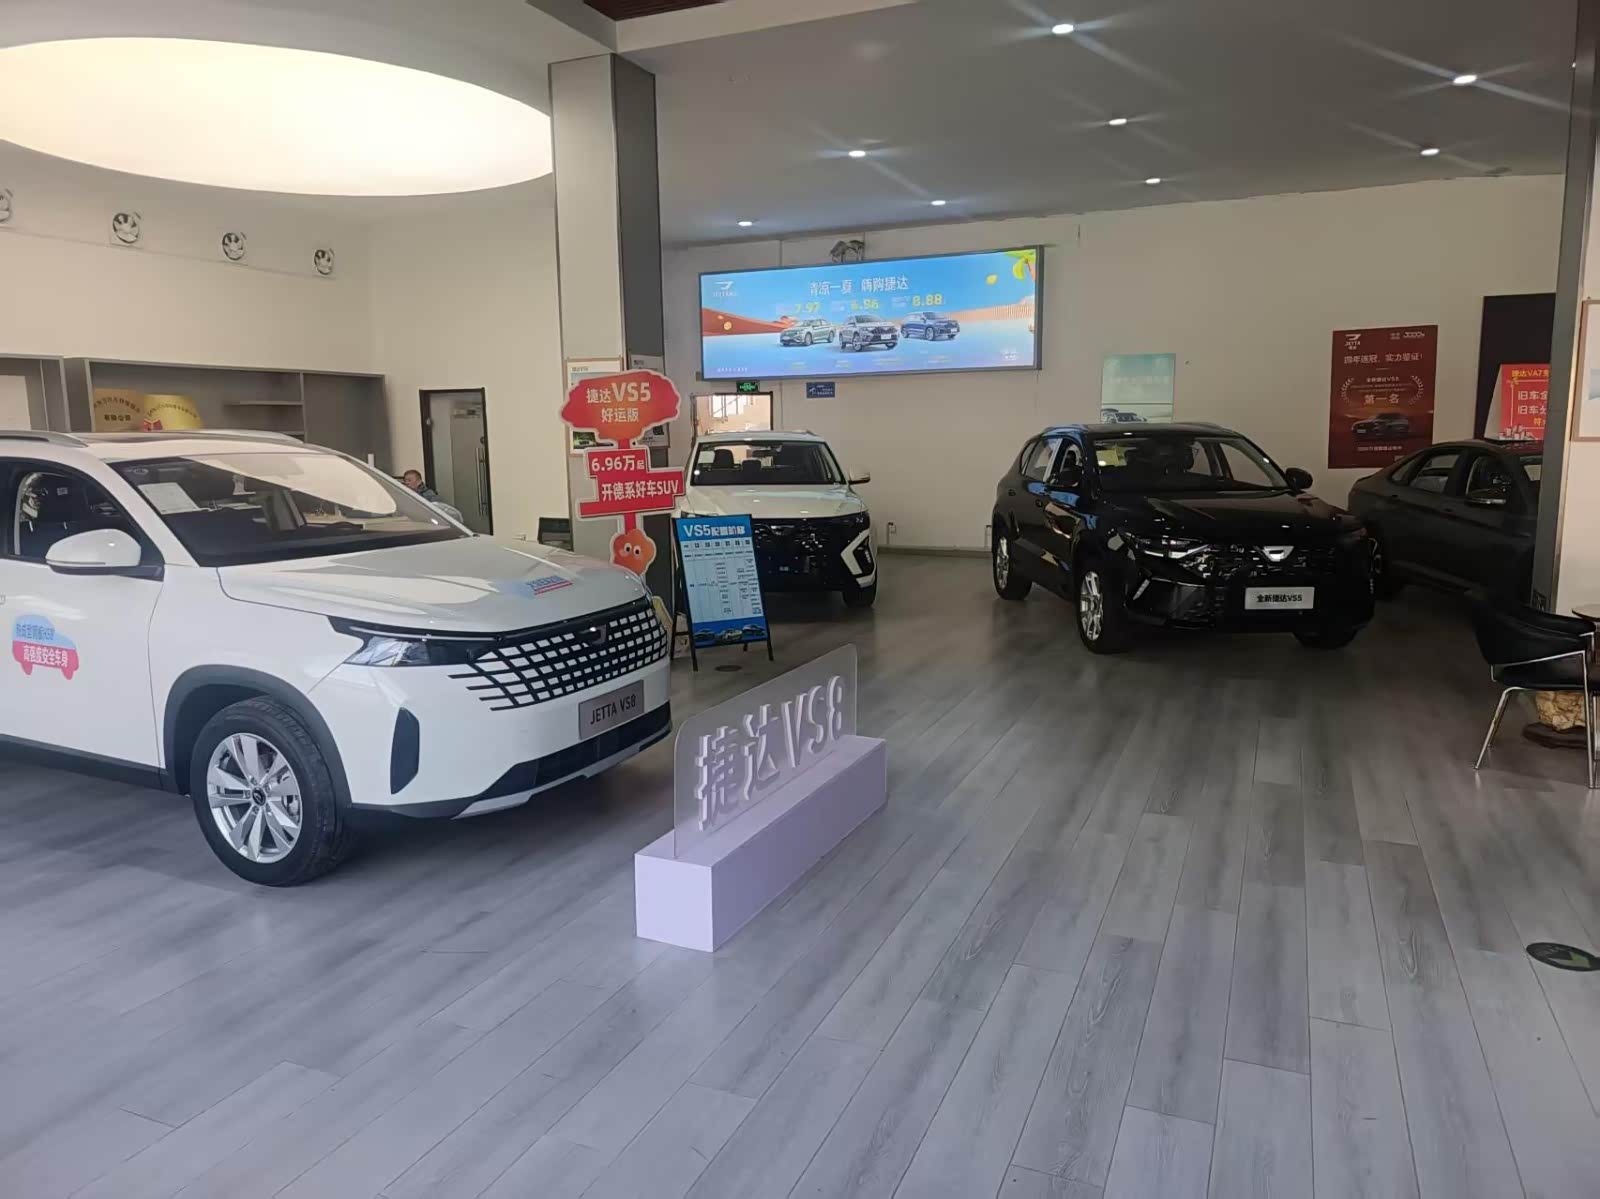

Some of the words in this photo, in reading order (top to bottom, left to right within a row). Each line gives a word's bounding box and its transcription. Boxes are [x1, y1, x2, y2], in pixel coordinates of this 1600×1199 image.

[586, 381, 651, 404] 捷达VS5
[1364, 393, 1399, 405] 第一名
[602, 407, 639, 423] 好运版
[591, 455, 645, 472] 6.96万起
[602, 480, 679, 502] 开德系好车SUV
[1256, 594, 1303, 603] 全新捷达VS5
[590, 701, 617, 725] JETTA
[620, 693, 636, 712] VS8
[695, 676, 843, 832] 捷达VS8
